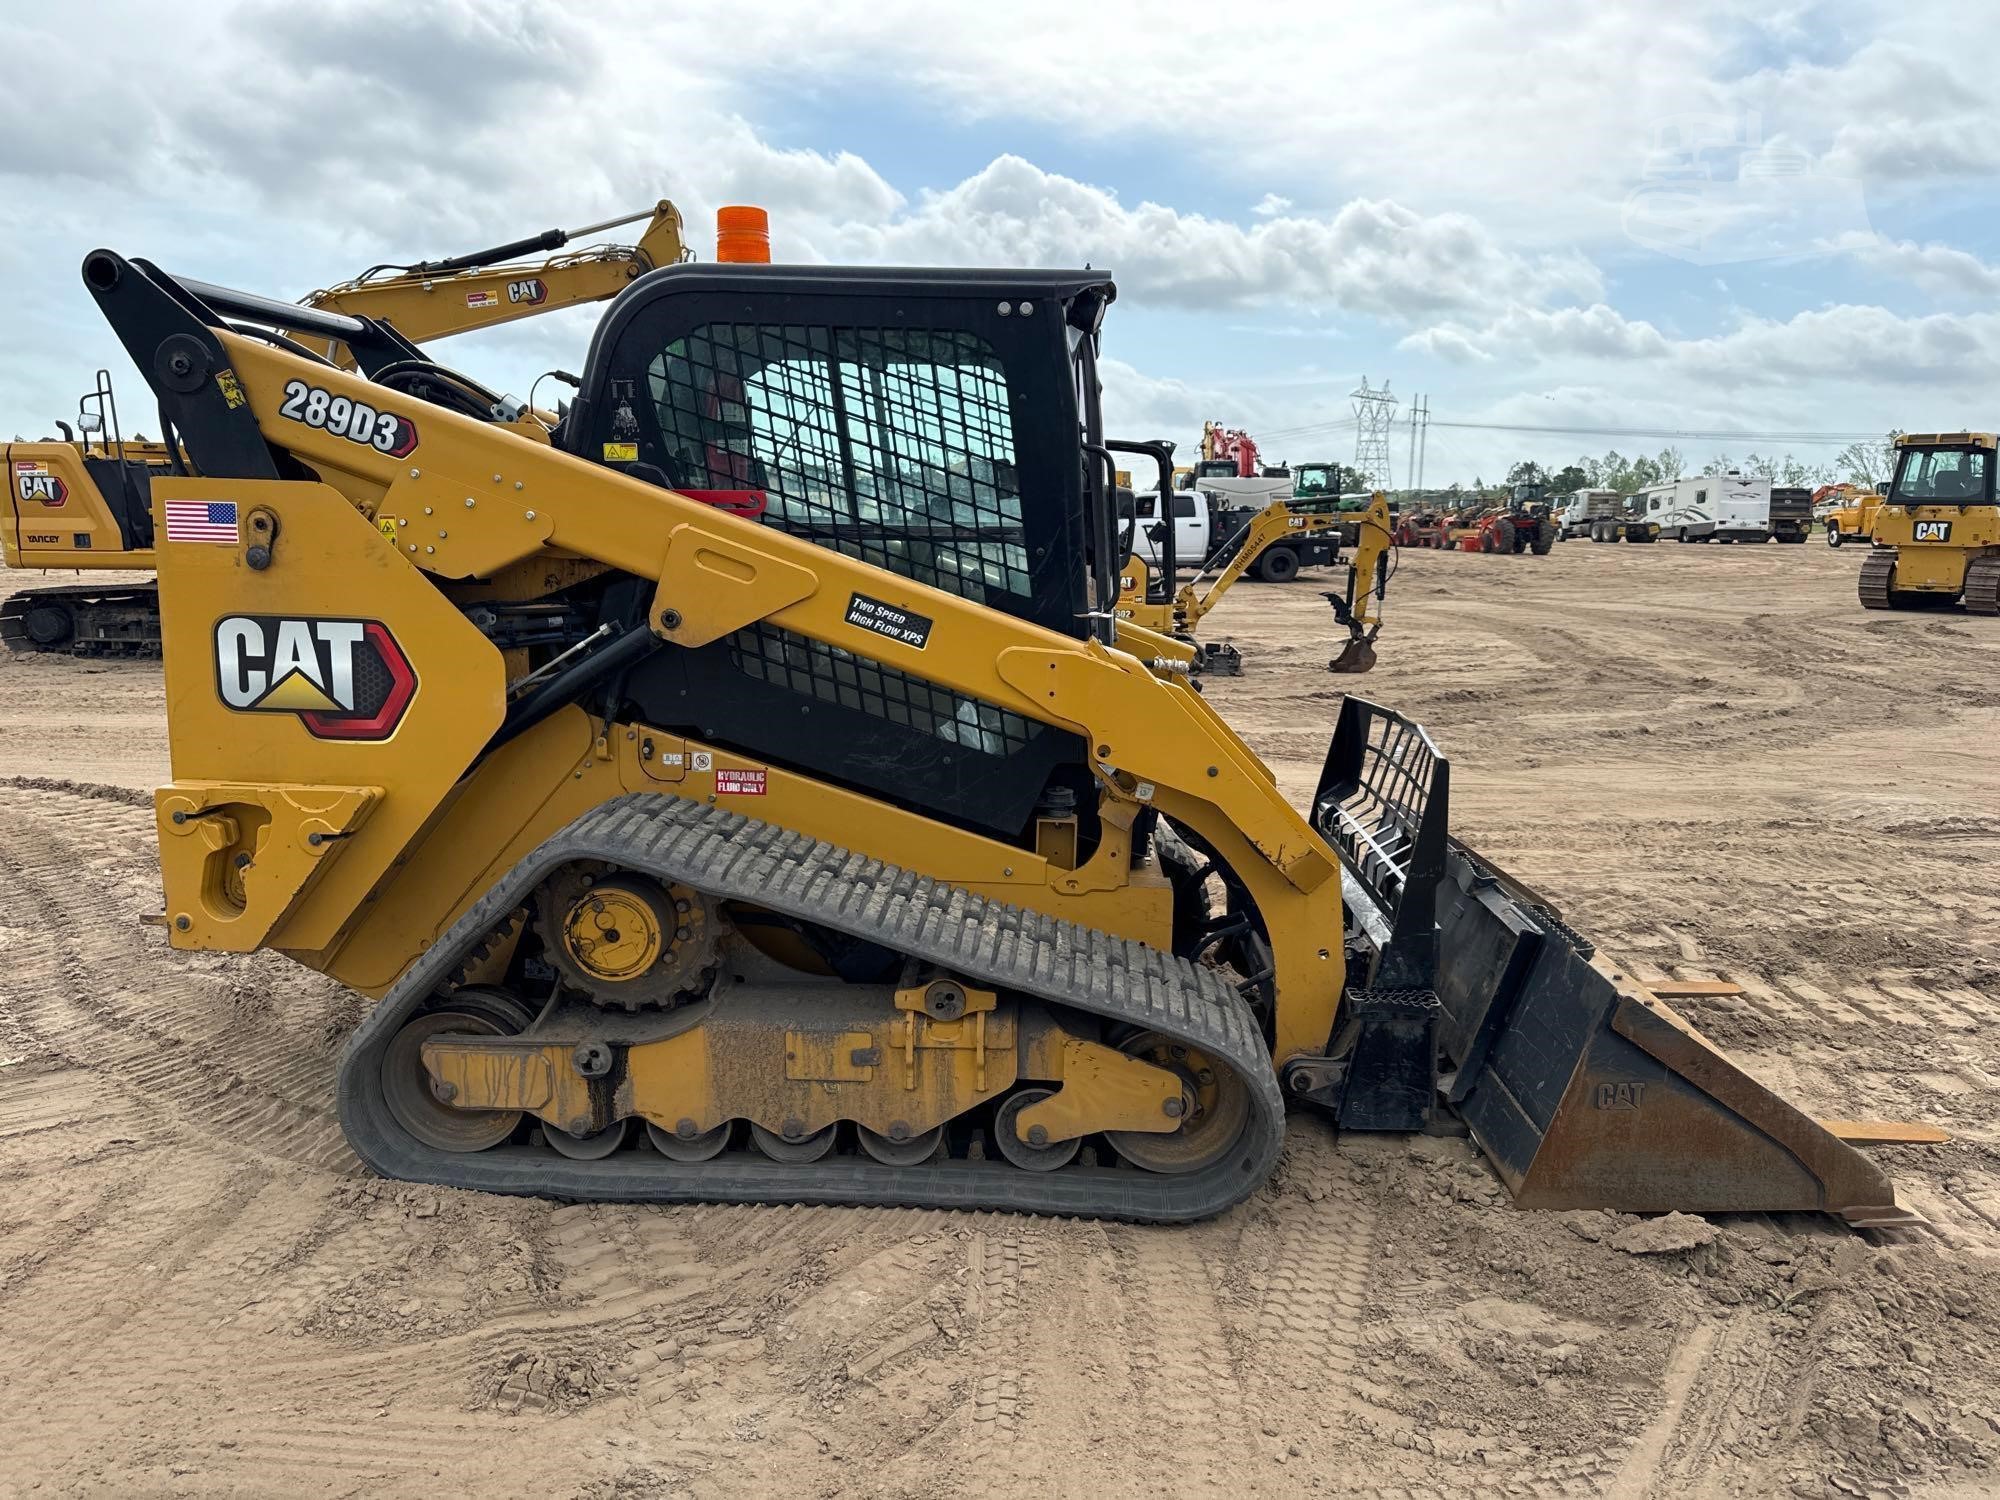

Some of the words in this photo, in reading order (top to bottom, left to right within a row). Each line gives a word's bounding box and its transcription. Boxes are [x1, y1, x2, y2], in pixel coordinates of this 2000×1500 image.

[508, 280, 537, 303] CAT
[281, 381, 399, 451] 289D3
[19, 477, 55, 500] CAT
[1288, 518, 1303, 527] CAT
[1916, 522, 1948, 540] CAT
[27, 535, 59, 543] YANCEY
[1120, 576, 1133, 588] AT
[853, 598, 875, 613] TWO
[875, 606, 906, 624] SPEED
[1115, 610, 1131, 618] 302
[849, 611, 874, 627] HIGH
[874, 620, 901, 636] FLOW
[900, 629, 924, 644] XPS
[217, 617, 364, 711] CAT
[717, 770, 765, 782] HYDRAULIC
[717, 782, 740, 792] FLUID
[742, 783, 765, 793] ONLY
[1597, 1082, 1645, 1110] CAT
